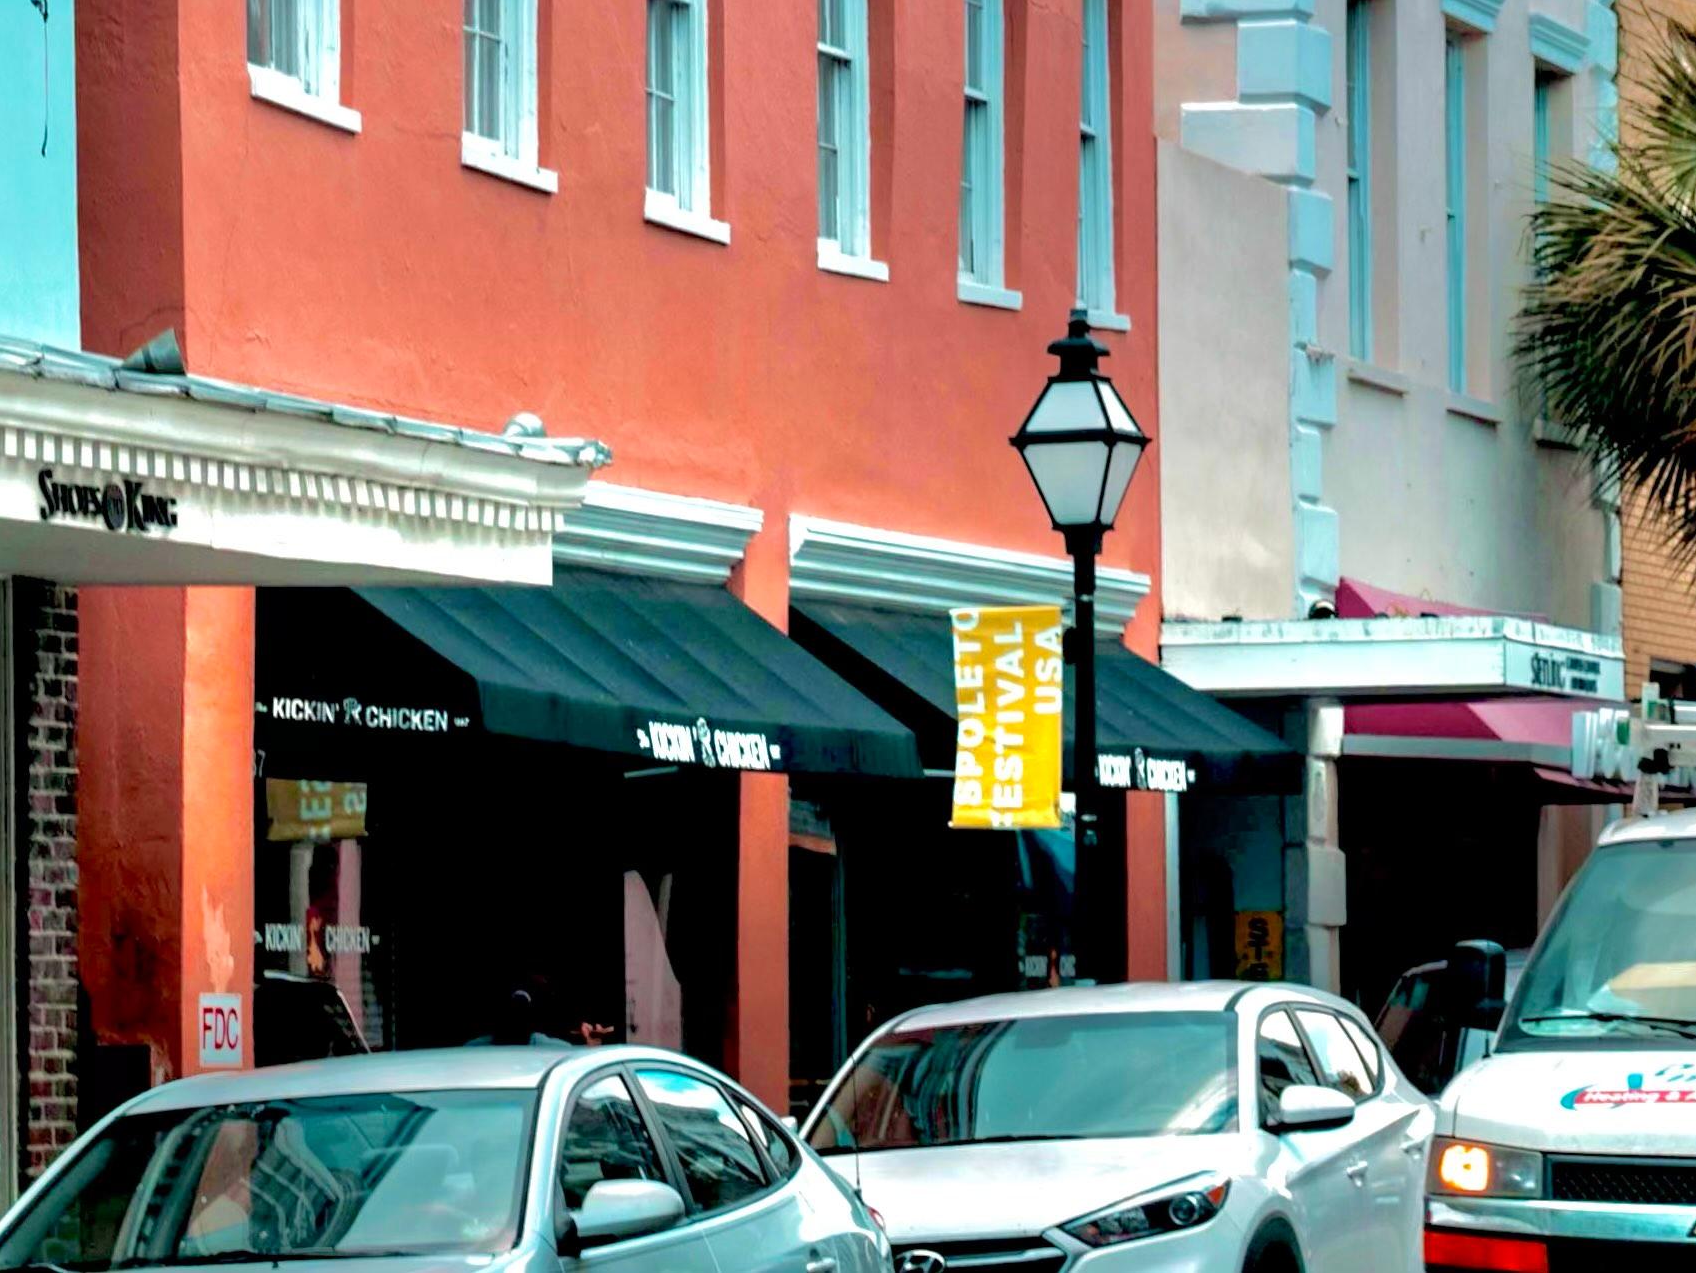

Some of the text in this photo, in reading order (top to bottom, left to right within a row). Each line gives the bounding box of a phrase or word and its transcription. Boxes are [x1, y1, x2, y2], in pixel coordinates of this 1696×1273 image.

[1034, 626, 1063, 714] USA
[272, 697, 340, 724] KICKIN'
[365, 705, 449, 732] CHICKEN
[952, 610, 986, 805] SPOLETO
[201, 1007, 240, 1050] FDC
